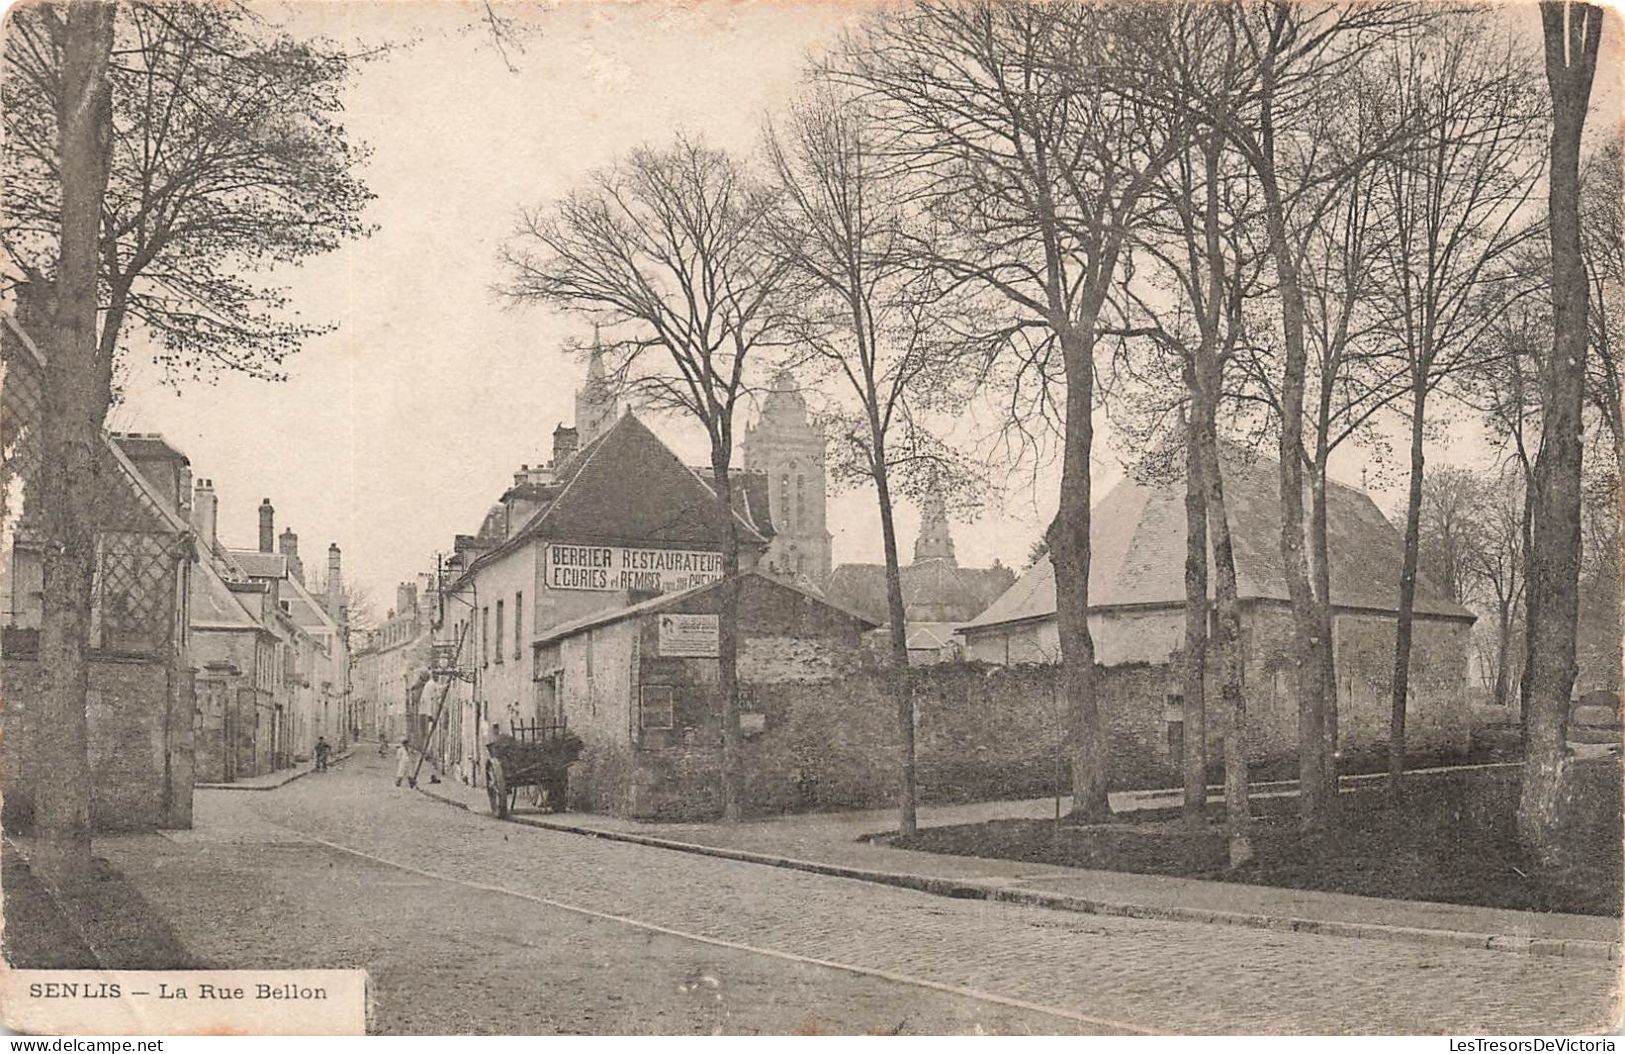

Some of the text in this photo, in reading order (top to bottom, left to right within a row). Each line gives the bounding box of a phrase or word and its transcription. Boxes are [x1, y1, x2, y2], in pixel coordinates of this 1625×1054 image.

[552, 546, 722, 571] BERRIER RESTAURATEUR
[554, 568, 606, 588] ECURIES
